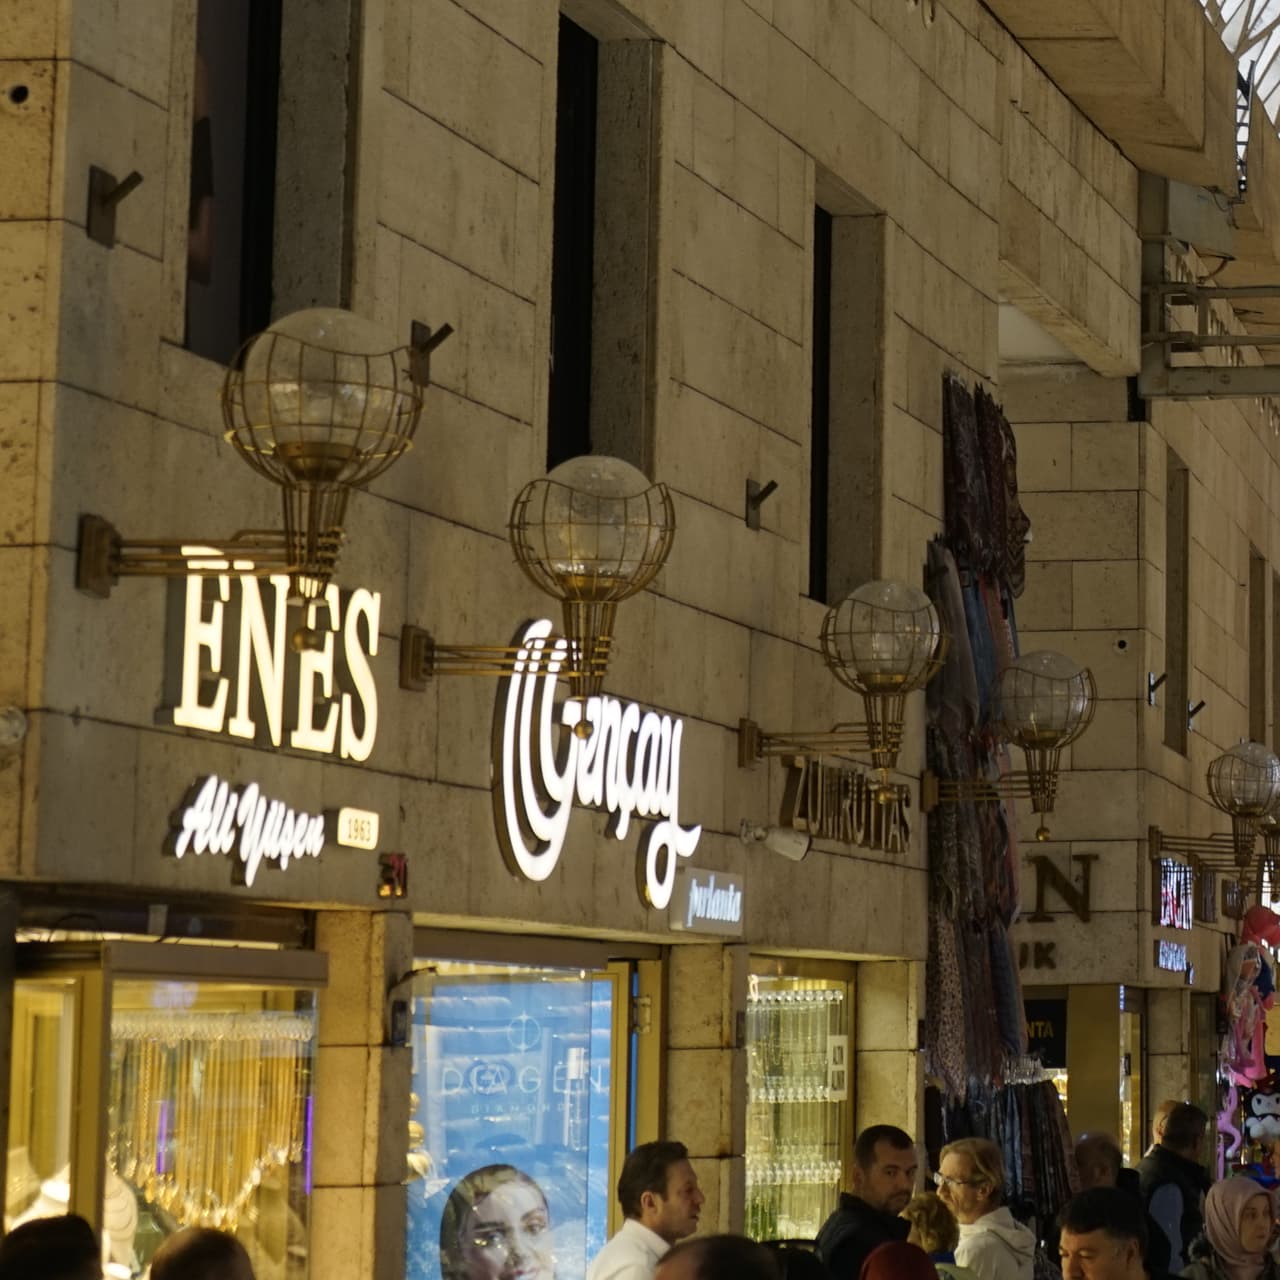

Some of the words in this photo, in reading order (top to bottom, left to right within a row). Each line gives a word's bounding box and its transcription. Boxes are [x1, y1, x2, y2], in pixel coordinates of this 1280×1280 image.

[174, 545, 381, 762] ENES
[347, 817, 372, 843] 1963
[503, 619, 702, 910] Gençay
